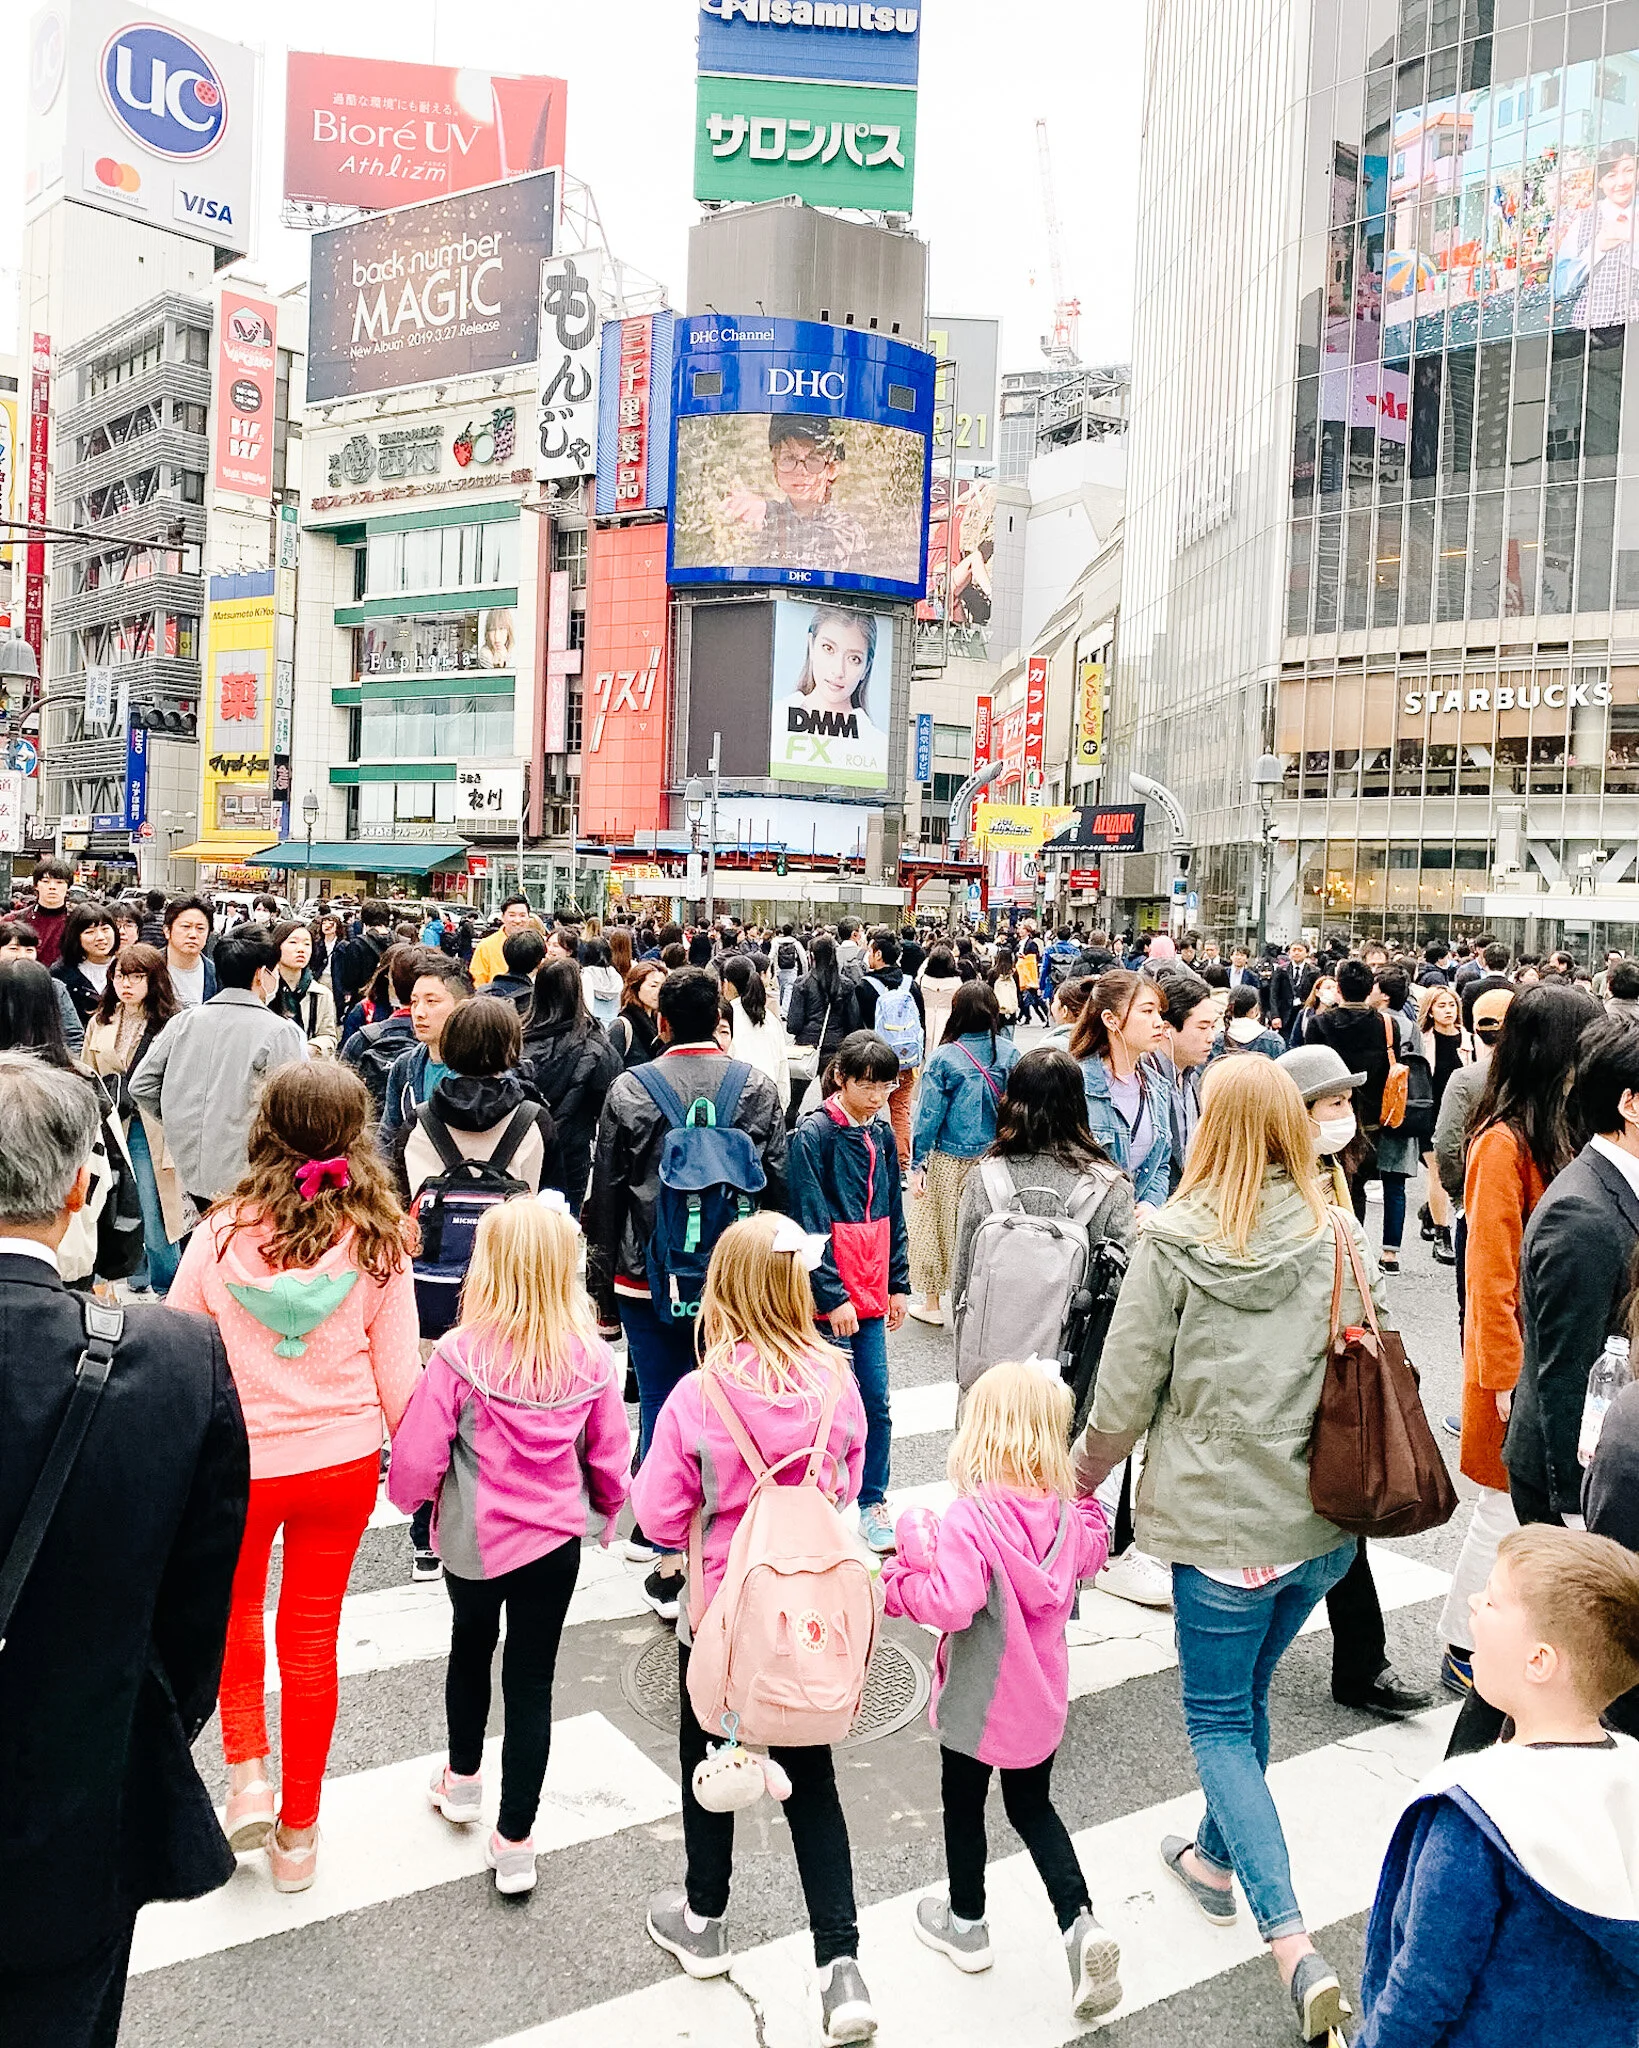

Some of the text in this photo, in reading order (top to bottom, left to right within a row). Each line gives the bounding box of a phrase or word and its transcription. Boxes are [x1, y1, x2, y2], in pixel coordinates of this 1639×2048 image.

[115, 45, 216, 132] UC
[313, 109, 482, 156] Bioré UV
[706, 113, 905, 168] サロンパス
[338, 154, 446, 182] Athlizm
[180, 189, 233, 225] VISA
[352, 232, 502, 287] back number
[351, 257, 504, 344] MAGIC
[350, 343, 372, 359] New
[373, 338, 404, 353] Album
[459, 320, 500, 336] Release
[689, 328, 775, 344] DHC Channel
[540, 258, 596, 471] もんじゃ
[767, 368, 845, 400] DHC
[616, 323, 645, 500] 三千里薬品
[956, 413, 988, 449] 21
[789, 571, 812, 582] DHC
[369, 649, 472, 674] Euphoria
[221, 672, 257, 721] 薬
[589, 646, 662, 753] クスリ
[1027, 667, 1045, 748] カラオケ
[1404, 681, 1615, 715] STARBUCKS
[788, 706, 859, 738] DMM
[786, 735, 877, 769] FX ROLA
[1084, 742, 1097, 754] 4F
